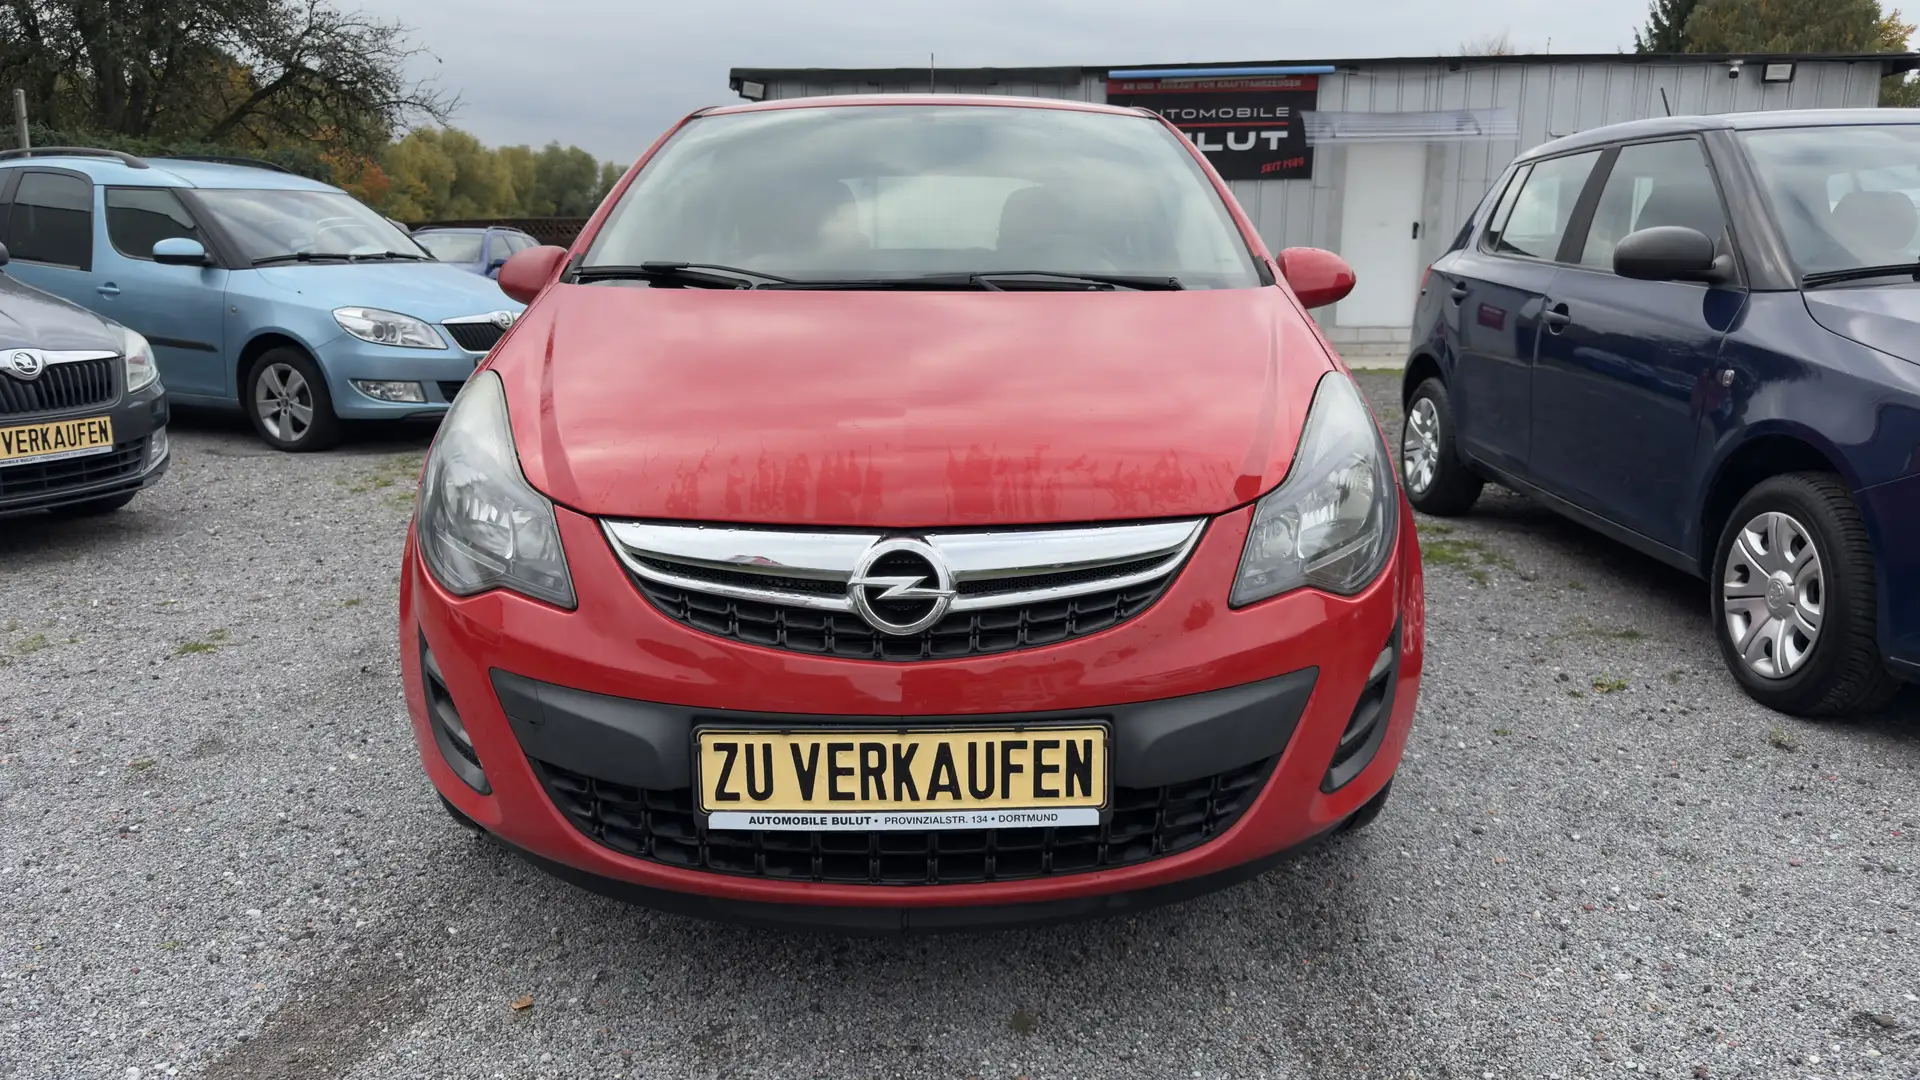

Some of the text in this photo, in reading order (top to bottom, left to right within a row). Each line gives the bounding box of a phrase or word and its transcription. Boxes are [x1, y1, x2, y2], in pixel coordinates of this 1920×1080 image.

[1160, 107, 1289, 119] TOMOBILE
[1185, 131, 1288, 151] LUT
[1, 420, 109, 455] VERKAUFEN
[713, 739, 1093, 801] ZU VERKAUFEN
[749, 816, 828, 825] AUTOMOBILE
[832, 816, 872, 825] BULUT
[884, 816, 968, 825] PROVINZIALSTR.
[999, 813, 1058, 823] DORTMUND
